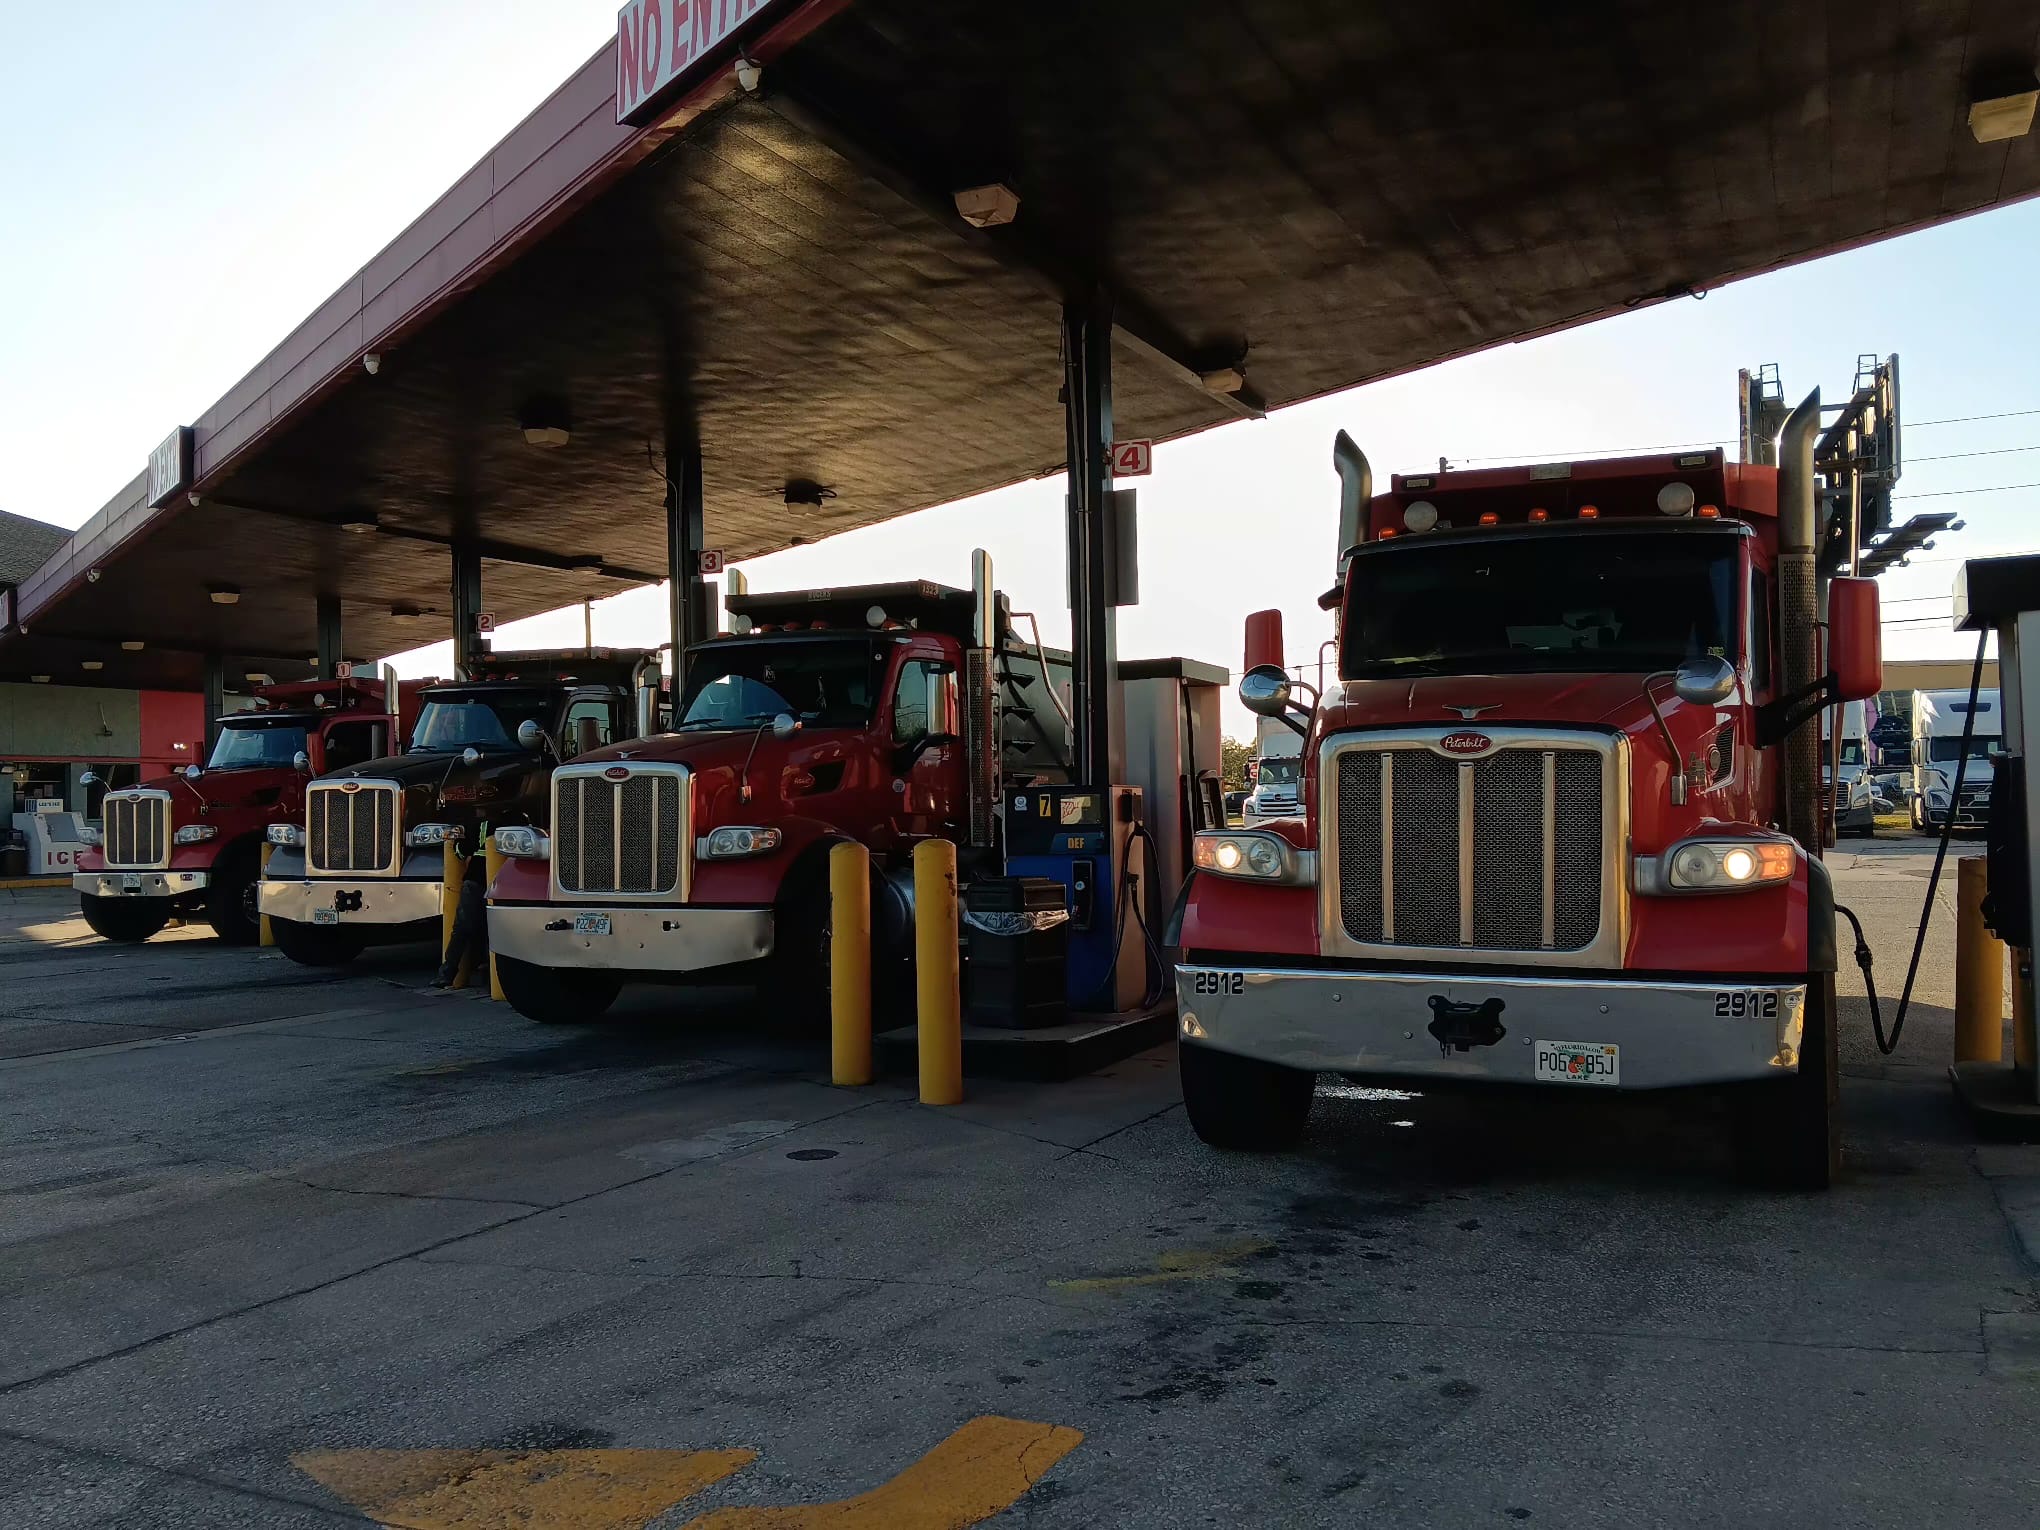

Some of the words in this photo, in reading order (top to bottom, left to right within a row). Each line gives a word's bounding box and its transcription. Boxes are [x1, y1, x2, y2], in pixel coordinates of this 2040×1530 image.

[620, 0, 662, 115] NO
[1119, 446, 1141, 470] 4
[705, 553, 716, 570] 3
[480, 616, 490, 629] 2
[1444, 736, 1488, 749] Peterbilt
[1040, 796, 1050, 815] 7
[1067, 837, 1085, 849] DEF
[1195, 972, 1244, 995] 2912
[1715, 992, 1778, 1018] 2912
